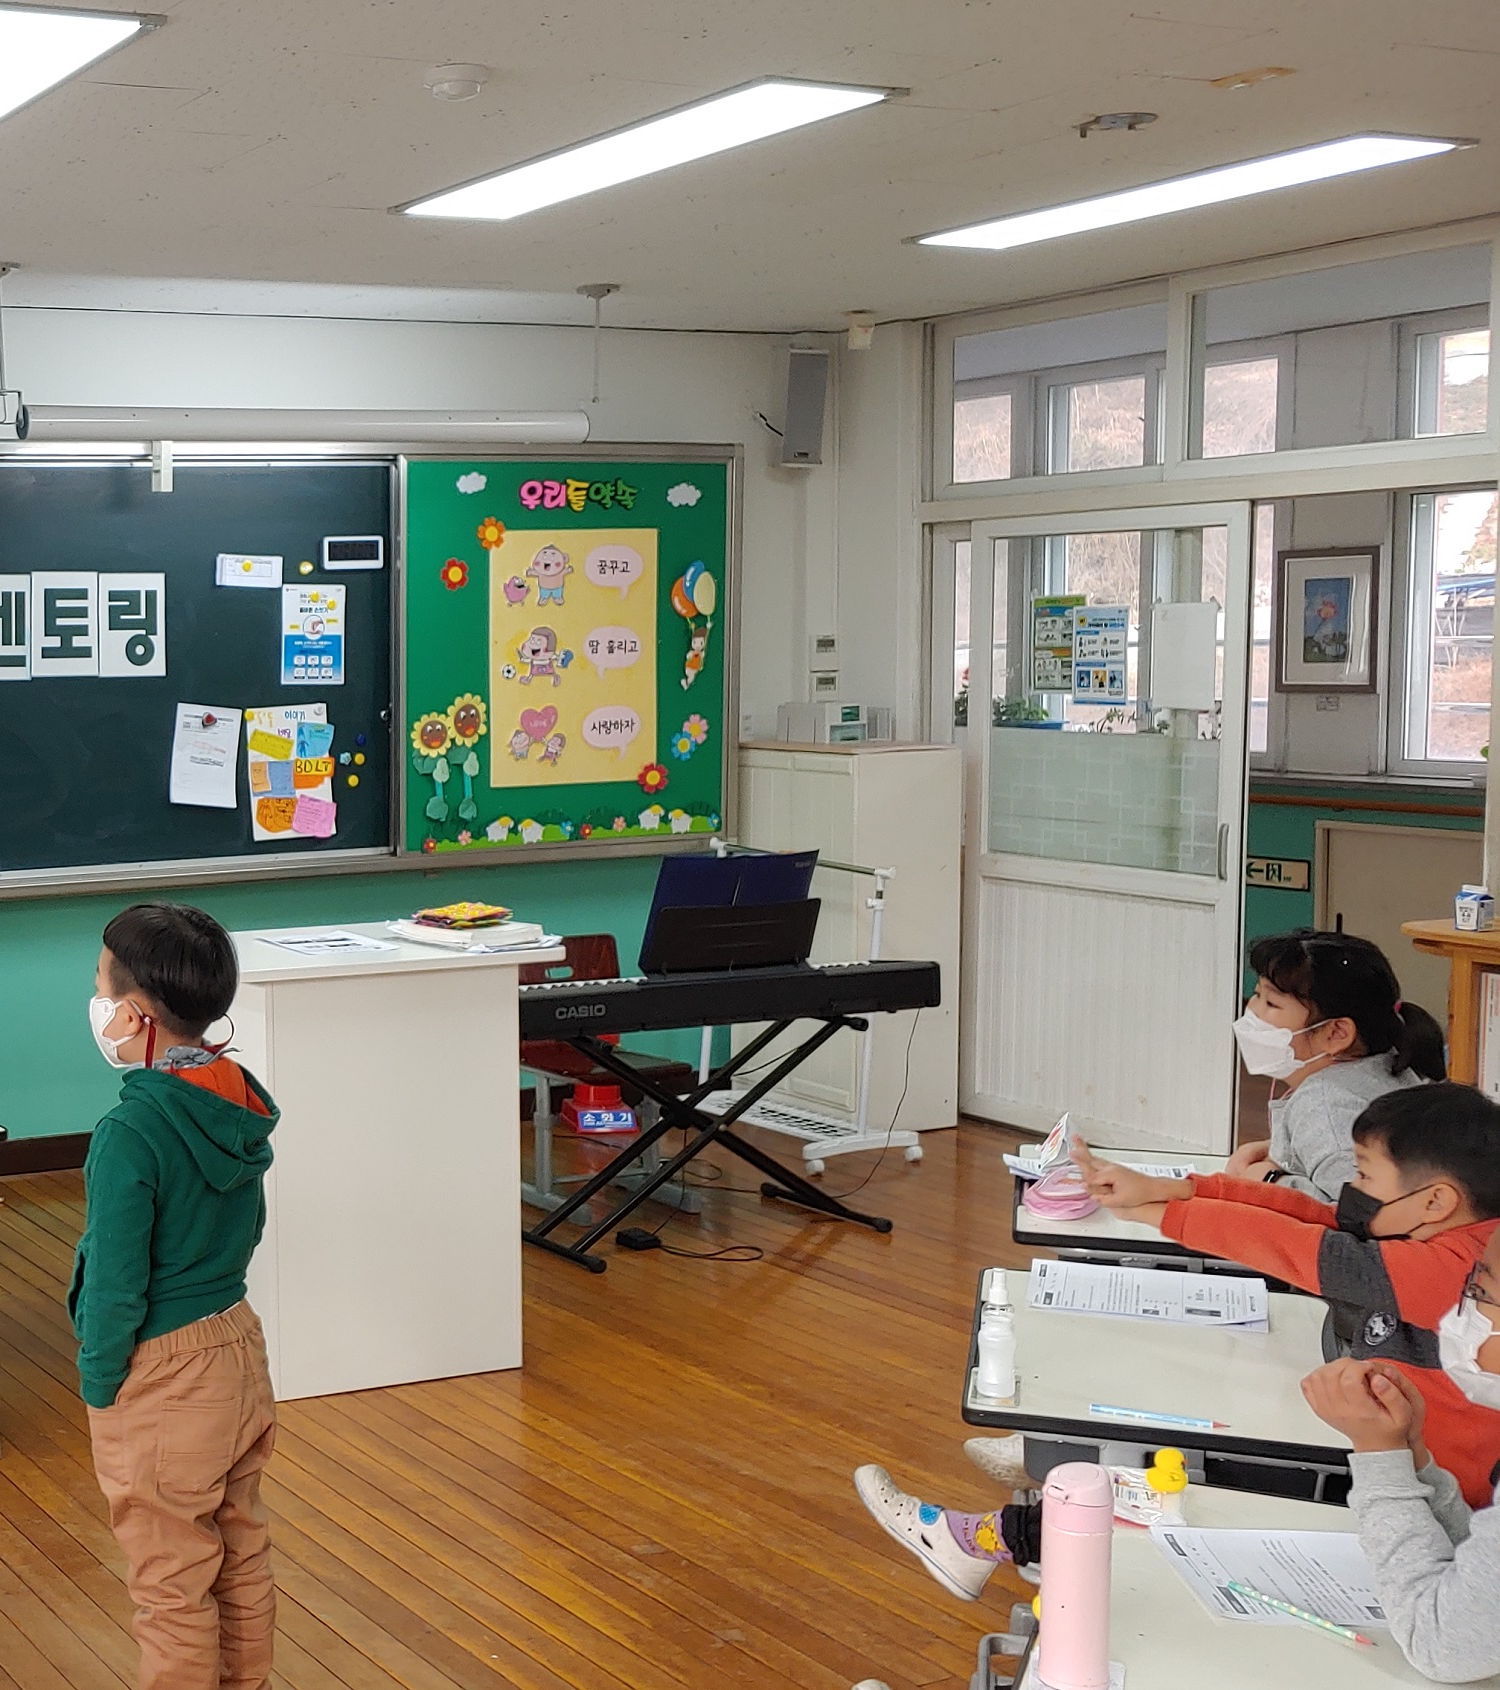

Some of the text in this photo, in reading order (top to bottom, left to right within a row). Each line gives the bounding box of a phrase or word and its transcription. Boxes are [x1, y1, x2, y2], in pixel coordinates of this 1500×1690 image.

[597, 559, 631, 575] 꿈꾸고
[588, 639, 601, 655] 땀
[590, 718, 636, 736] 사랑하자
[555, 1003, 606, 1020] CASIO
